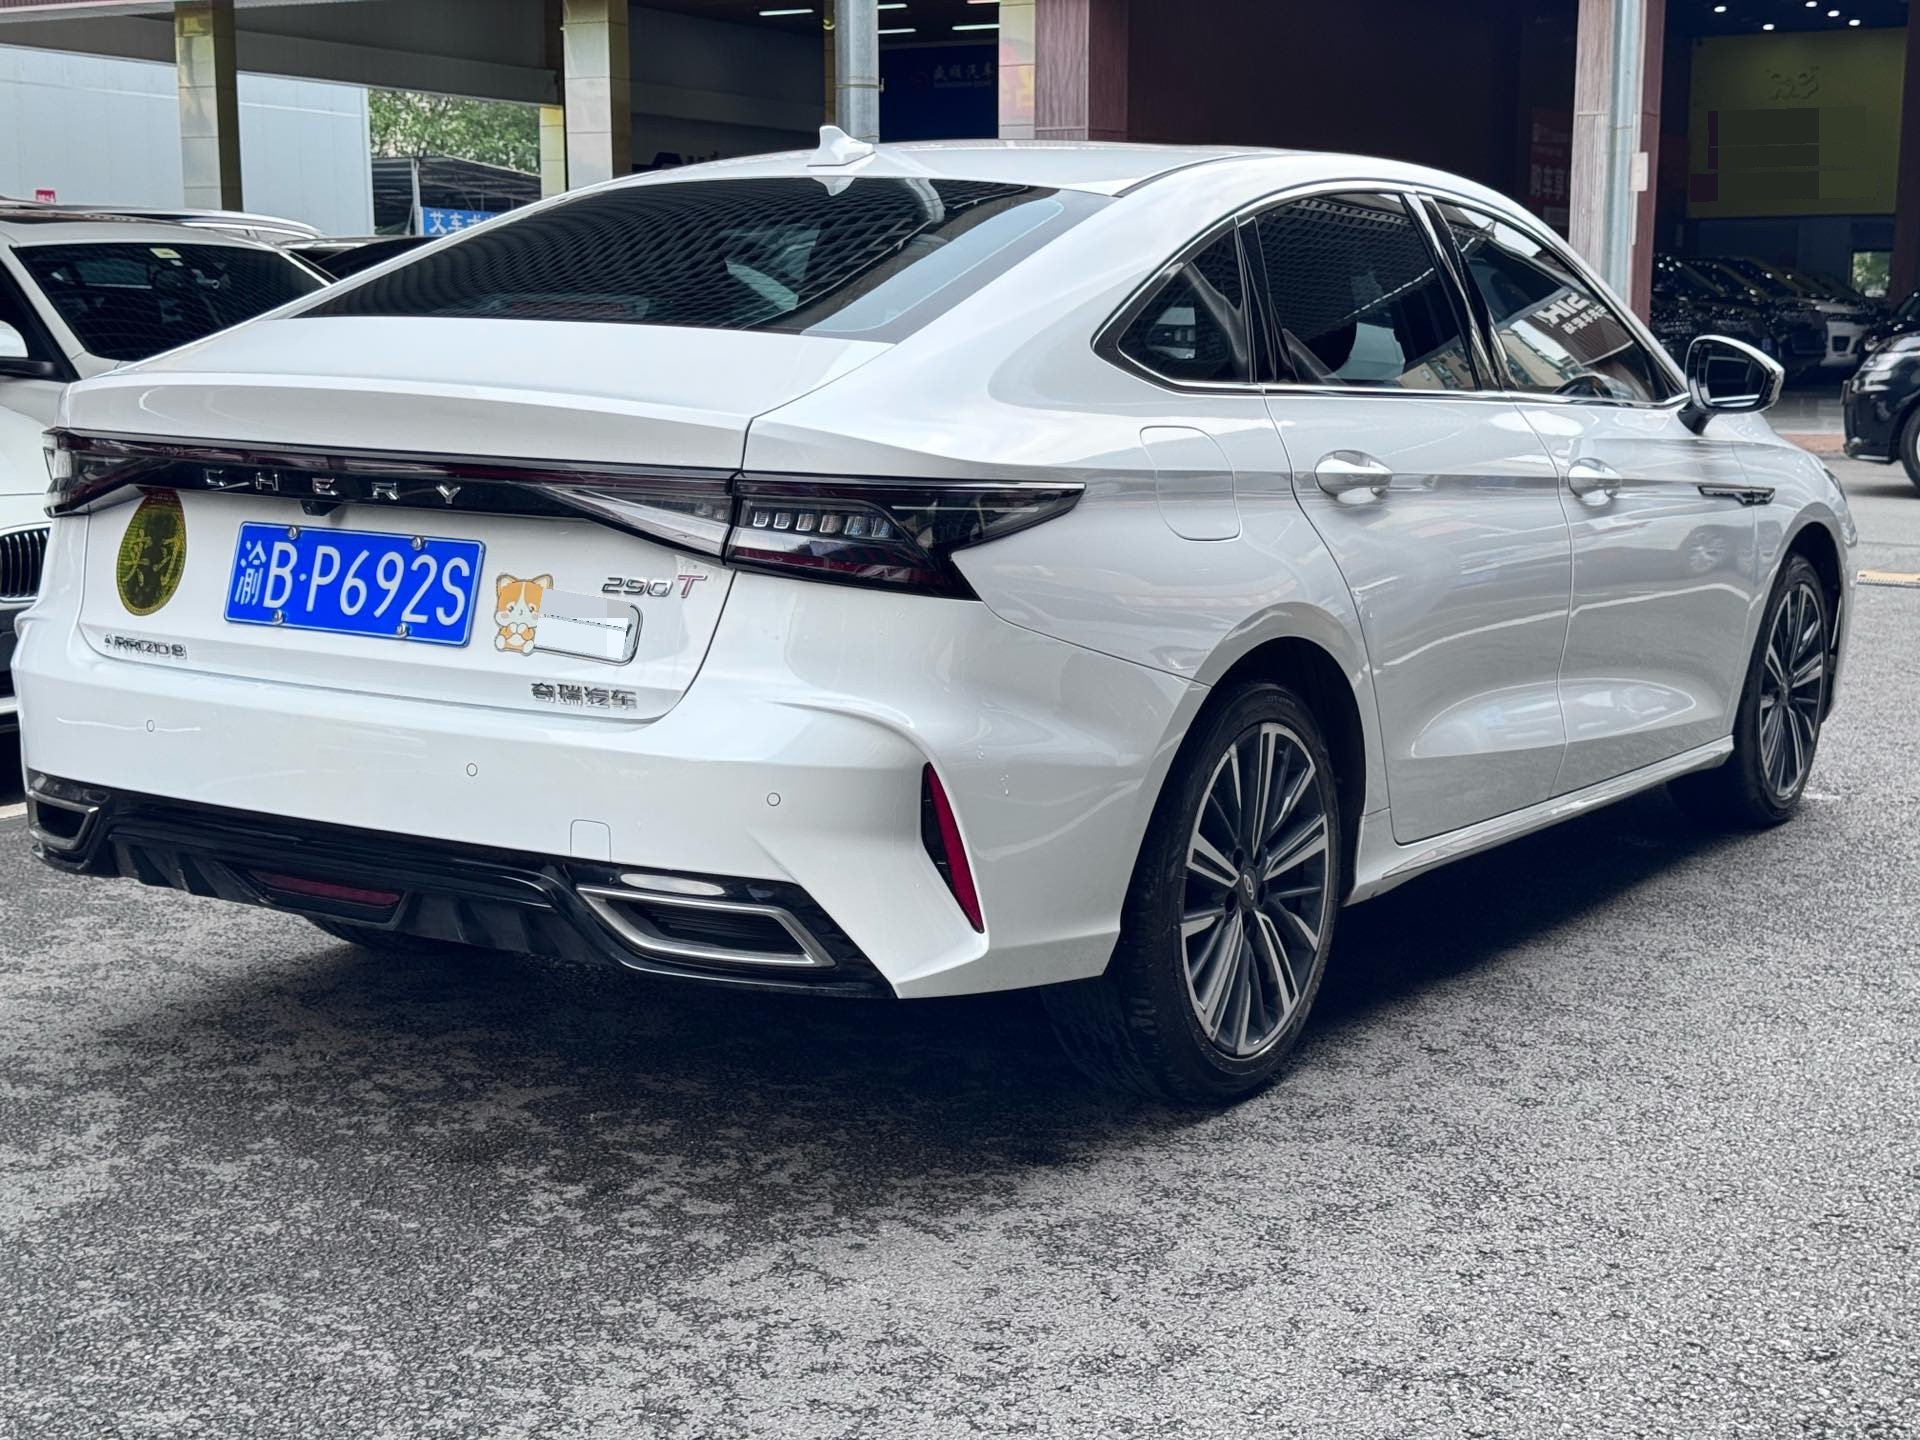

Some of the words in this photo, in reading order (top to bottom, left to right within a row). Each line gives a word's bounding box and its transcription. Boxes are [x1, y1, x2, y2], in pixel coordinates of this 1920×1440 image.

[429, 210, 495, 235] 艾车
[204, 469, 461, 504] CHERY
[601, 574, 708, 599] 290T
[530, 682, 638, 710] 奇瑞汽车
